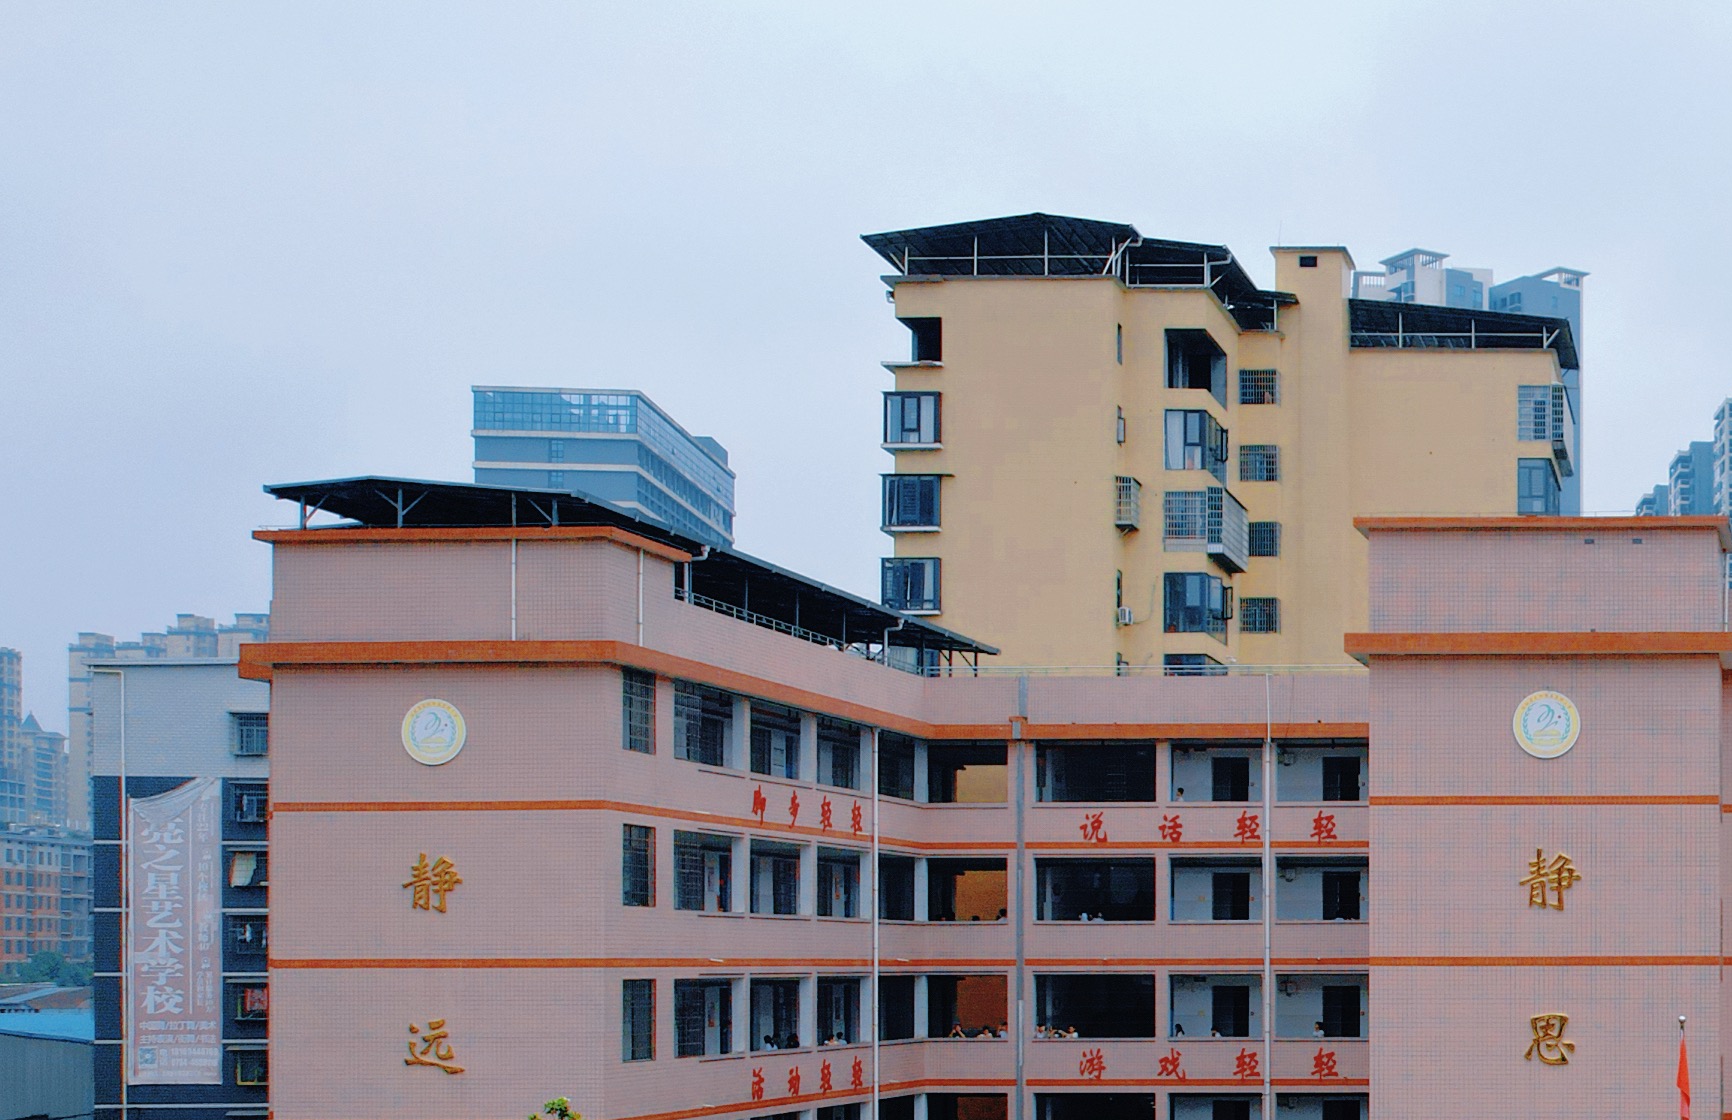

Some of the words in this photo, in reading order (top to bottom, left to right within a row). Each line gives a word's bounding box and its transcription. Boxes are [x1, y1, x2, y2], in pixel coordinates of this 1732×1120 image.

[751, 784, 863, 836] 脚步轻轻
[1080, 811, 1338, 843] 说话轻轻
[751, 1055, 863, 1101] 活动轻轻
[1080, 1047, 1340, 1079] 游戏轻轻
